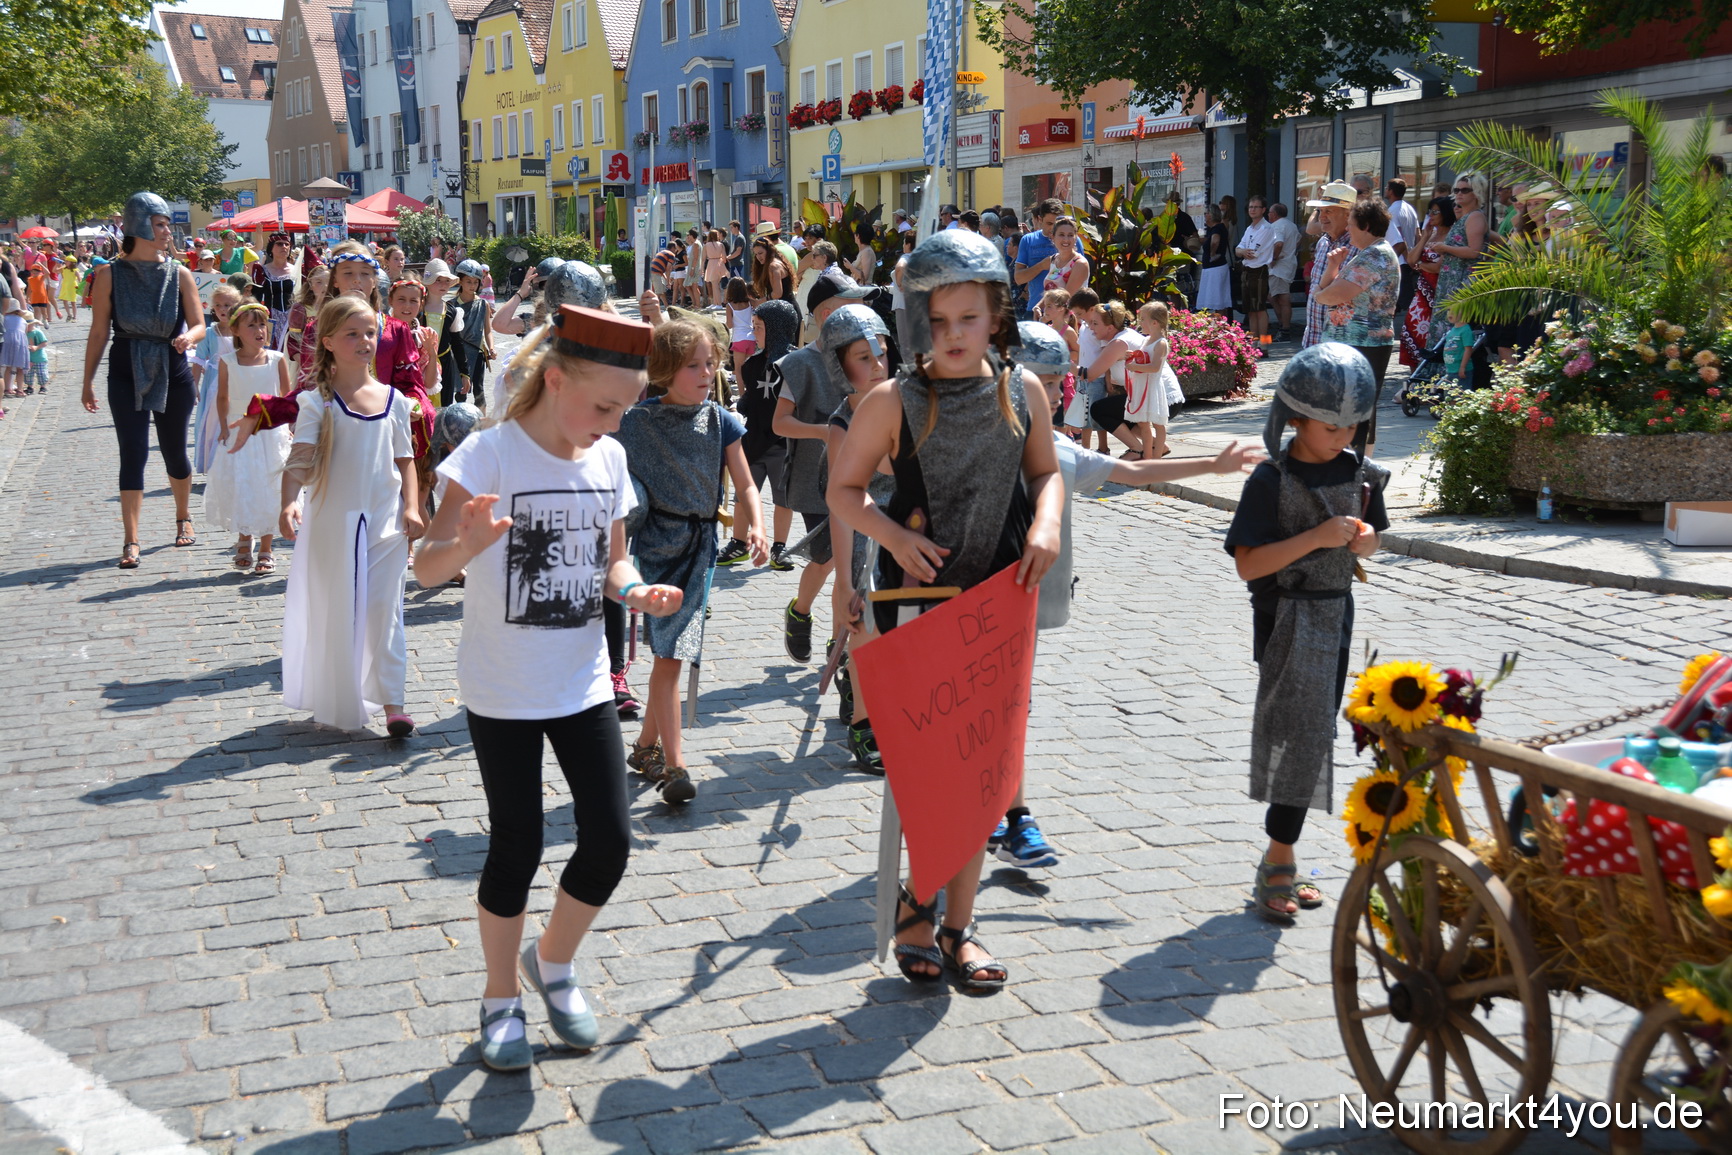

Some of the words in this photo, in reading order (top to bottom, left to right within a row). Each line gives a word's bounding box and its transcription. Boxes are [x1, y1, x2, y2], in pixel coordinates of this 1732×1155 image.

[496, 91, 515, 110] HOTEL
[520, 88, 541, 104] Lehmeier
[1052, 126, 1069, 135] DER
[1085, 107, 1093, 135] P
[826, 157, 837, 179] P
[497, 178, 524, 190] Restaurant
[530, 508, 608, 532] HELLO
[546, 540, 598, 567] SUN
[530, 573, 602, 603] SHINE
[958, 598, 999, 646] DIE
[956, 708, 996, 761] UND
